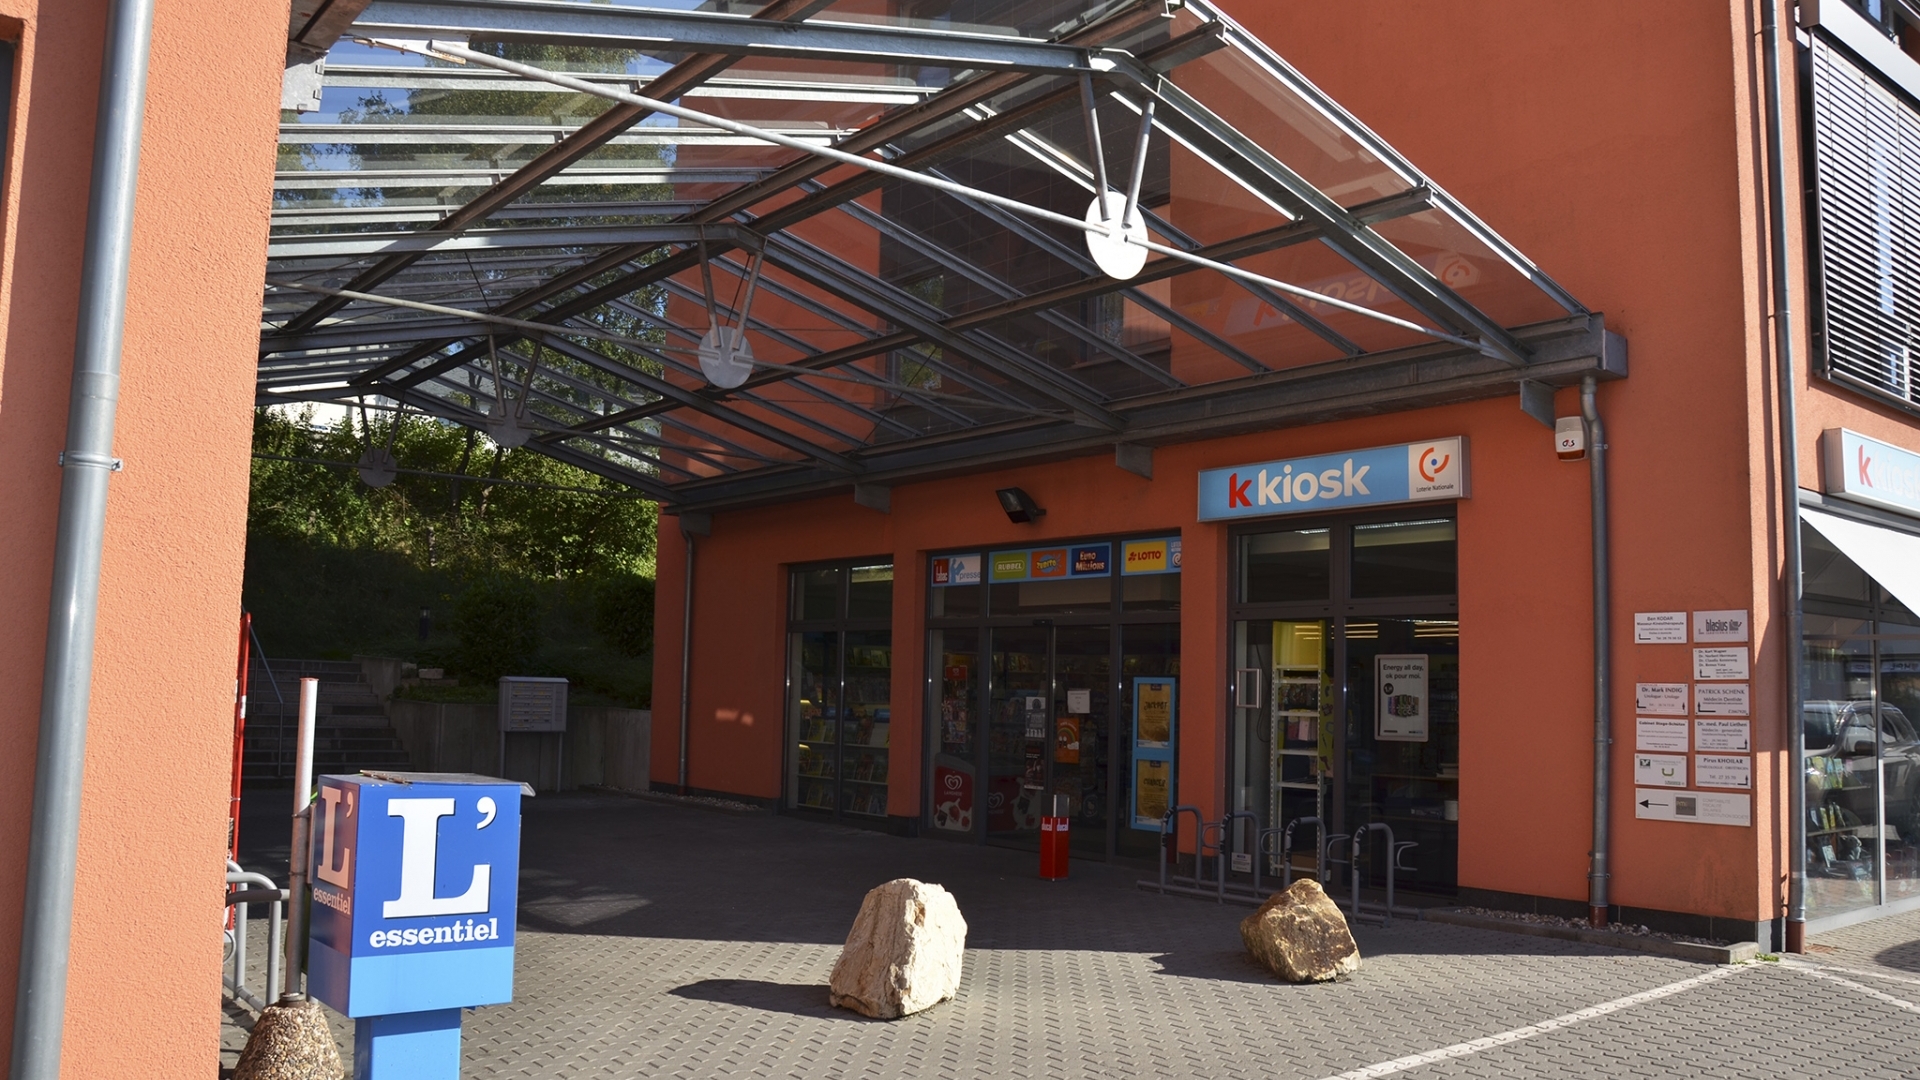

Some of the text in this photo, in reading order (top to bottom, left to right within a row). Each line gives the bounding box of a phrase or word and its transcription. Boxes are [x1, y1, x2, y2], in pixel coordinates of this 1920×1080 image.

[1858, 444, 1873, 488] k
[1228, 458, 1371, 508] k kiosk
[1432, 483, 1454, 492] Nationale
[1079, 551, 1097, 560] Euro
[1137, 550, 1162, 560] LOTTO
[997, 562, 1022, 571] RUBBEL
[1075, 561, 1106, 572] Millions
[959, 571, 981, 581] presse
[1706, 618, 1728, 631] blasius
[382, 796, 498, 919] L'
[313, 887, 351, 915] essentiel
[370, 918, 499, 948] essentiel
